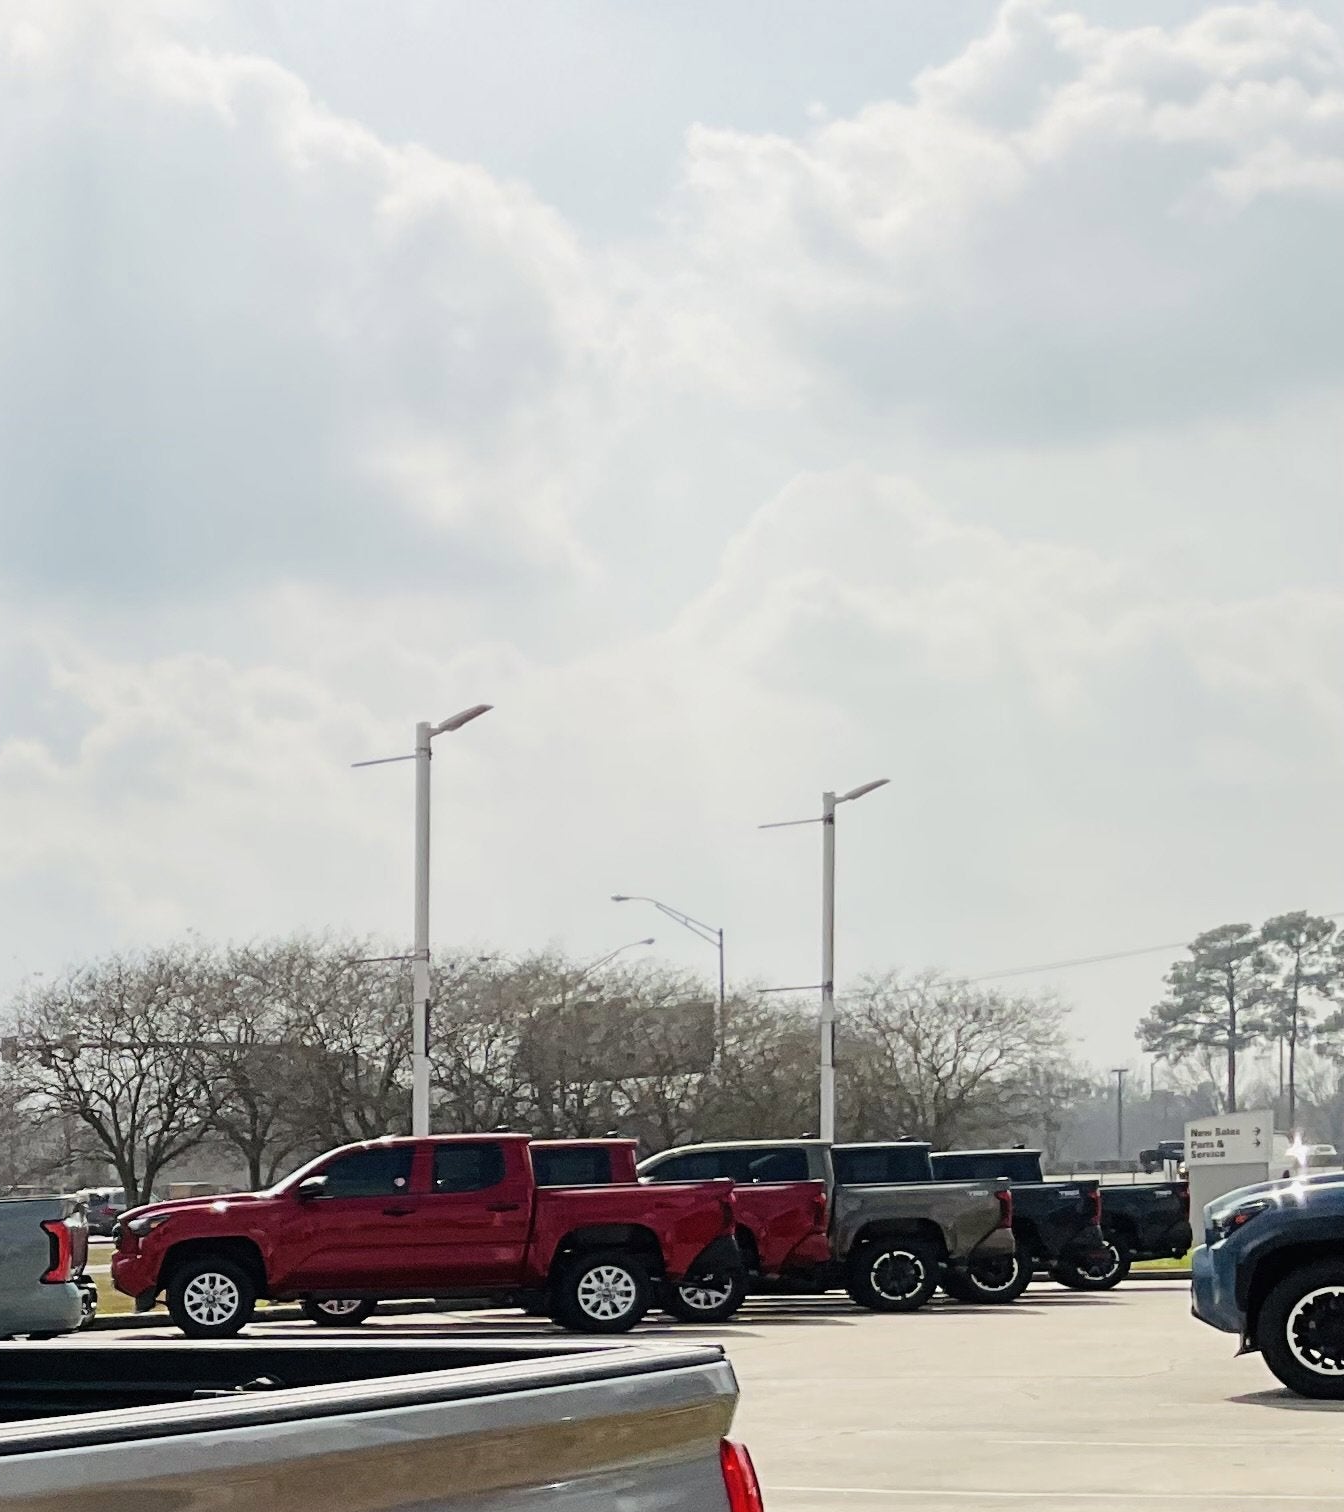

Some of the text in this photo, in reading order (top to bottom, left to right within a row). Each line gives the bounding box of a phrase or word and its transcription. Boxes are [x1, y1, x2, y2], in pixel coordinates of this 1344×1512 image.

[1191, 1128, 1241, 1137] New Sales
[1191, 1150, 1226, 1158] Service
